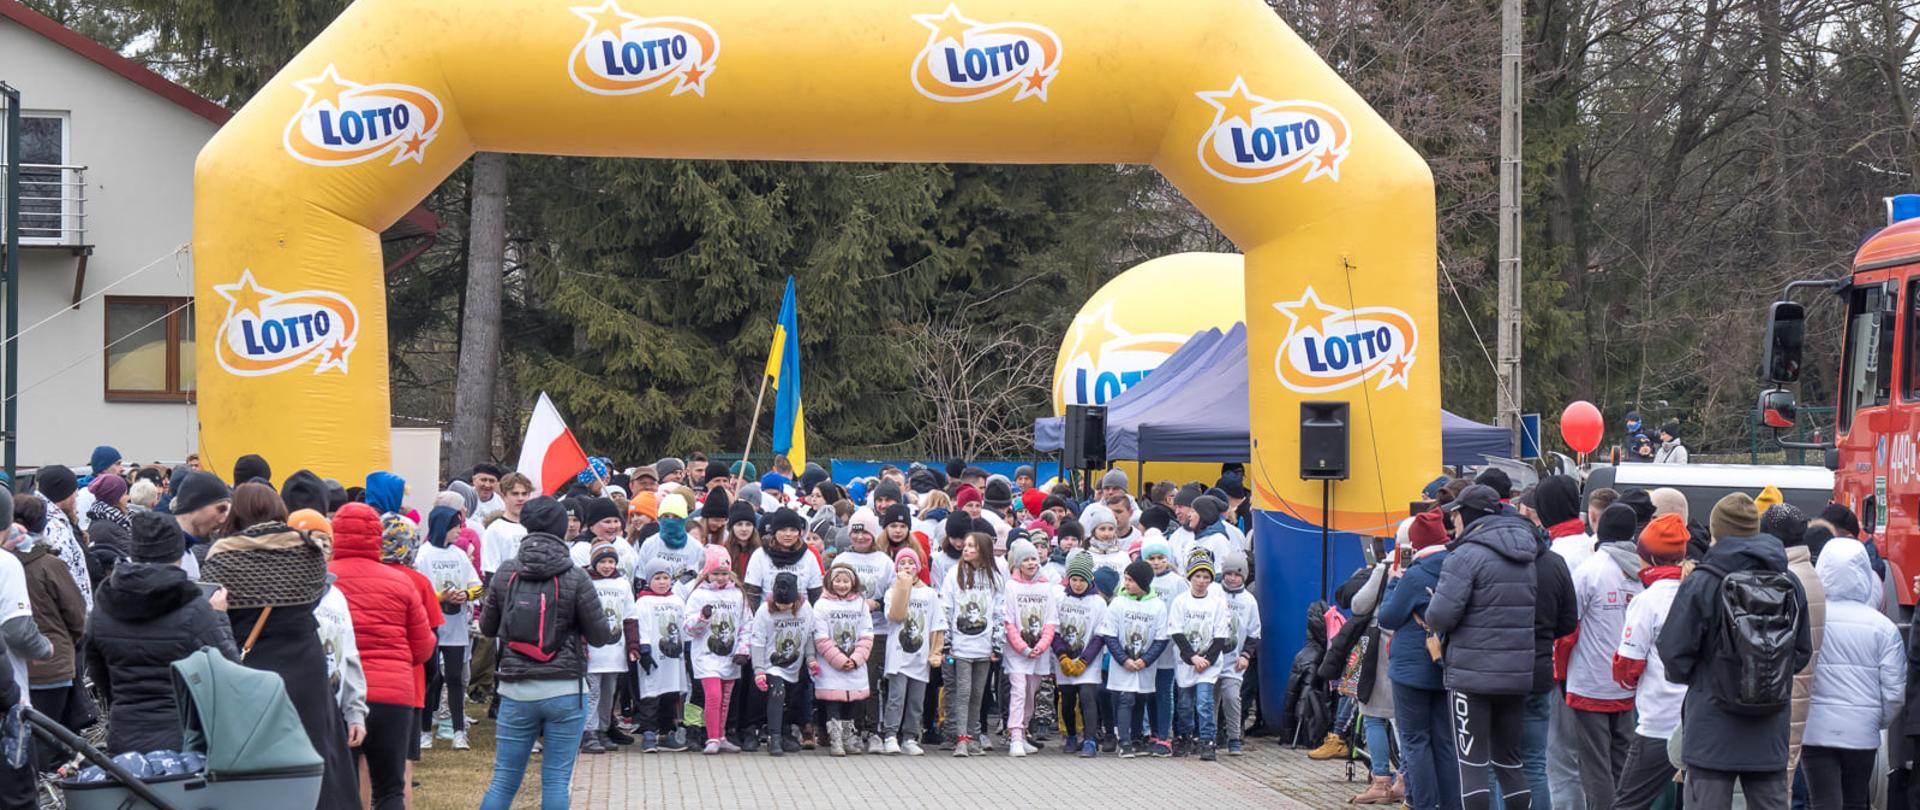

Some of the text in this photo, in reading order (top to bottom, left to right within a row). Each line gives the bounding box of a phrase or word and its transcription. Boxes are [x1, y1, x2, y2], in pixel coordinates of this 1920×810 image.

[603, 36, 687, 74] LOTTO
[946, 41, 1028, 82] LOTTO
[319, 105, 410, 145] LOTTO
[1232, 119, 1320, 163] LOTTO
[242, 309, 331, 355] LOTTO
[1303, 326, 1392, 373] LOTTO
[1076, 367, 1153, 404] LOT
[1891, 434, 1910, 485] 449
